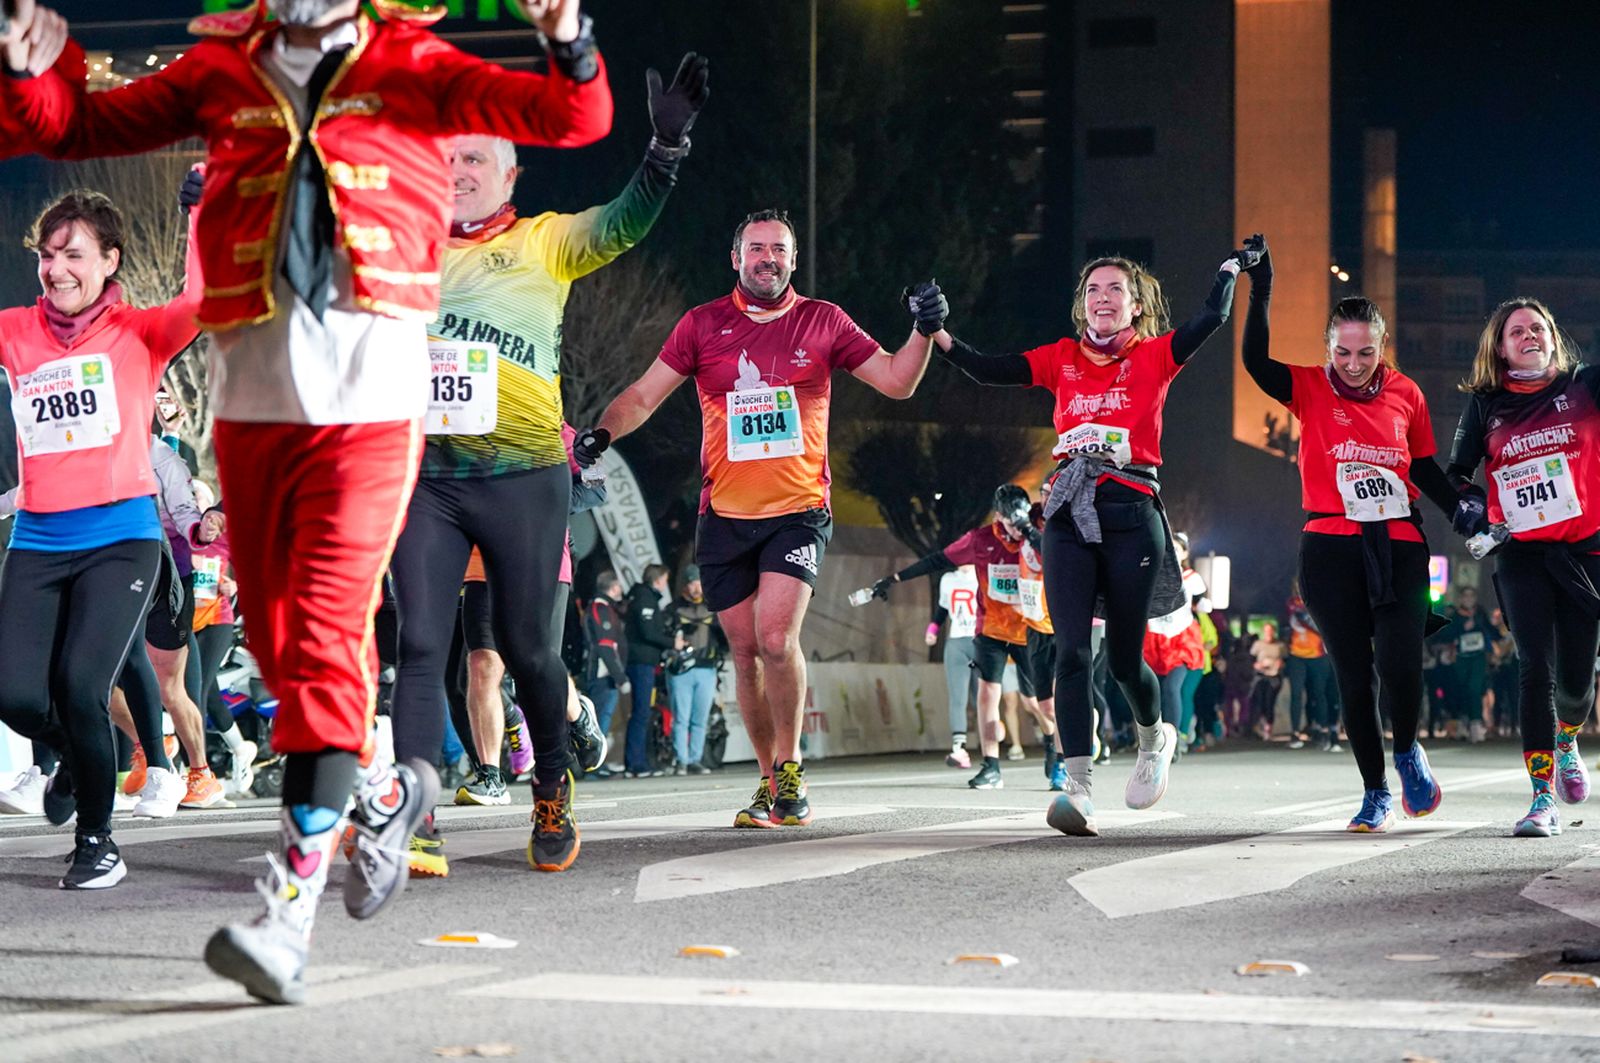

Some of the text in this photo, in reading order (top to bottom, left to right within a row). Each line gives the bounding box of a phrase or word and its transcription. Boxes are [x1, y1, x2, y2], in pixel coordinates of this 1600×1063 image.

[439, 313, 536, 370] PANDERA
[430, 352, 444, 361] CHE
[32, 368, 73, 384] NOCHE DE
[22, 385, 41, 398] SAN
[431, 376, 472, 401] 135
[31, 389, 97, 424] 2889
[742, 396, 762, 405] NOCHE
[734, 406, 748, 415] SAN
[742, 411, 787, 436] 8134
[1507, 428, 1569, 459] ANTORCHA
[1334, 441, 1399, 467] ANTORCHA
[1566, 451, 1581, 460] ANY
[1345, 473, 1360, 482] SAN
[1506, 480, 1520, 490] SAN
[1516, 479, 1558, 508] 5741
[997, 578, 1018, 591] 864
